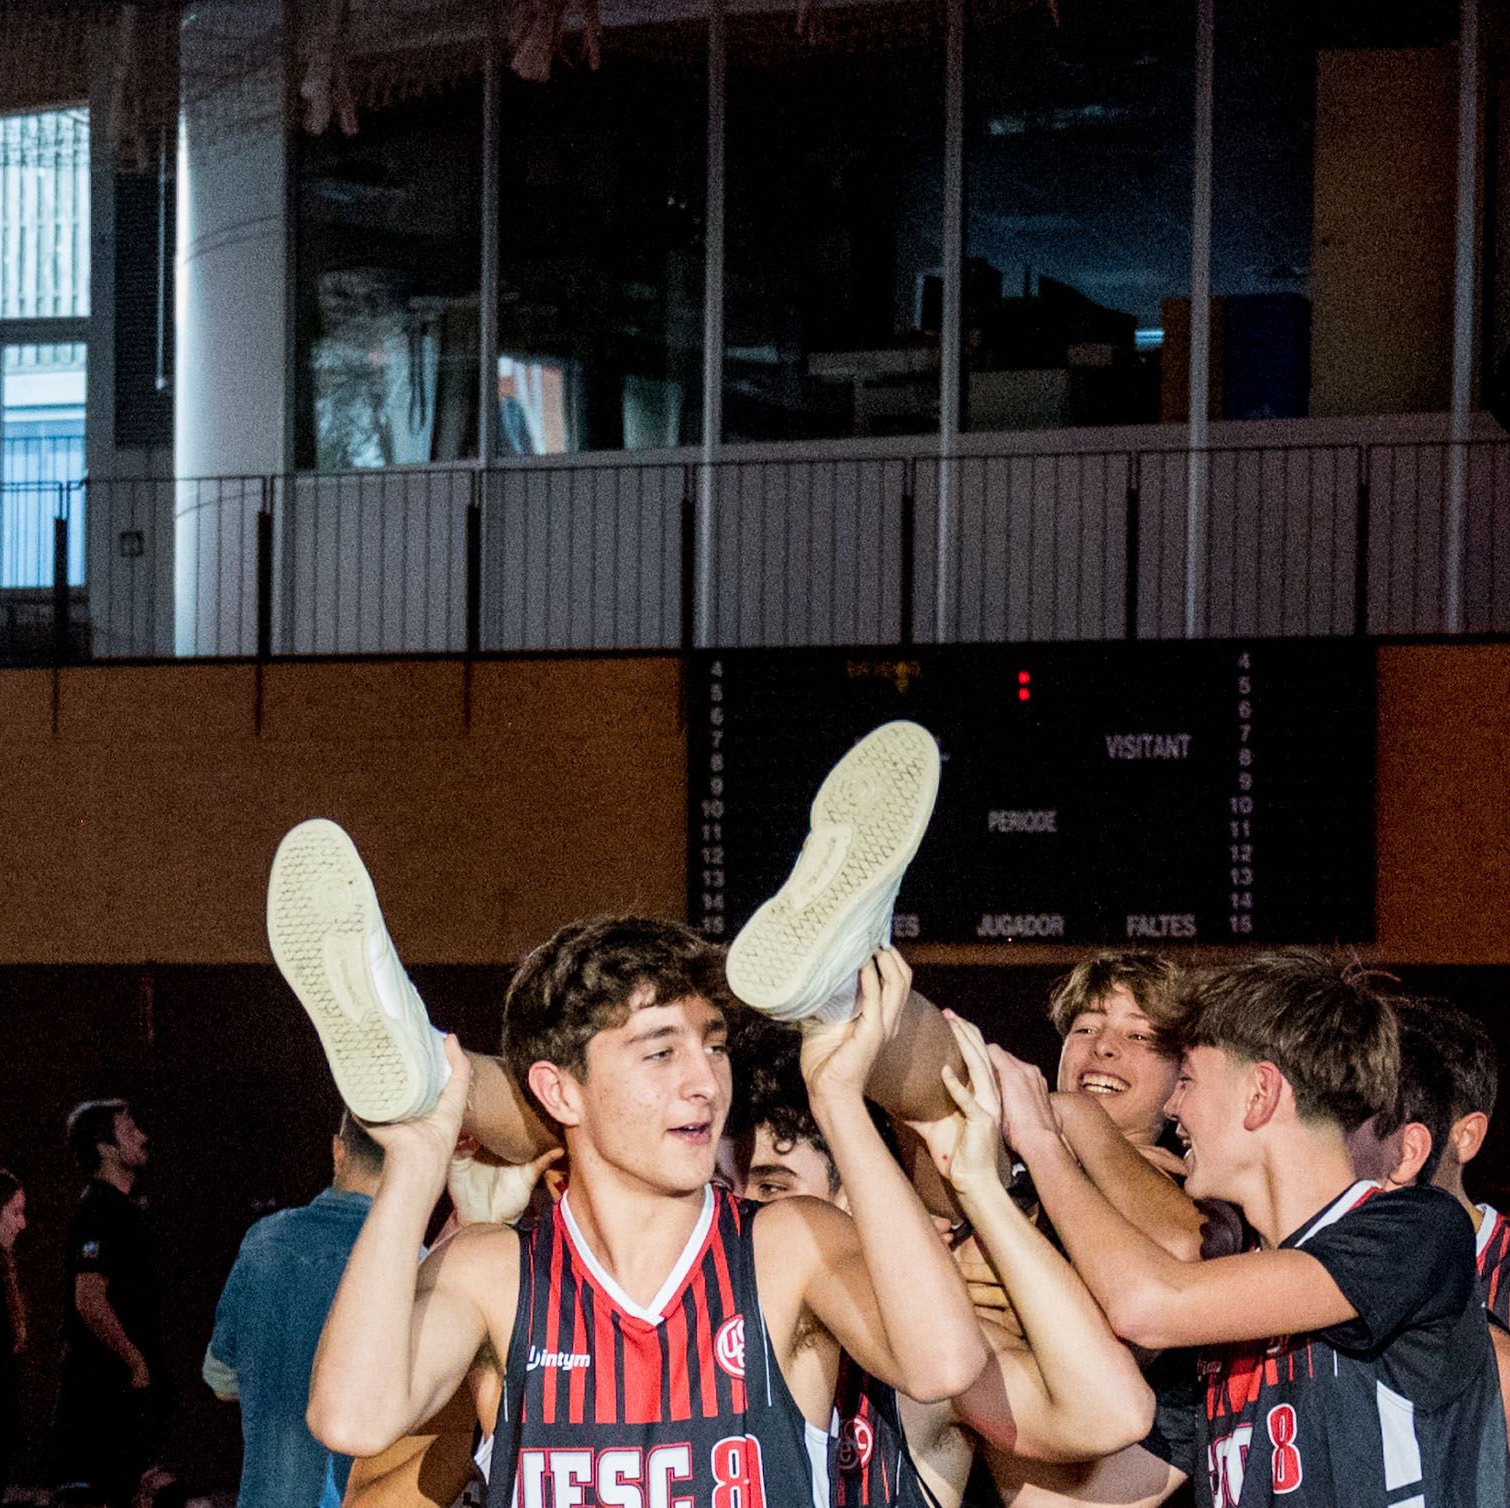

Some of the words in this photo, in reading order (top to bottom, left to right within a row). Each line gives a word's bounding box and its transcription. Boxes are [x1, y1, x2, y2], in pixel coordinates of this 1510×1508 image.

[710, 660, 723, 677] 4
[1238, 652, 1251, 669] 4
[710, 684, 723, 702] 5
[1238, 676, 1251, 694] 5
[710, 707, 724, 725] 6
[1238, 700, 1252, 718] 6
[710, 730, 723, 747] 7
[1240, 724, 1251, 741] 7
[1105, 732, 1191, 760] VISITANT
[710, 752, 724, 772] 8
[1239, 748, 1252, 766] 8
[710, 776, 724, 795] 9
[1239, 772, 1252, 790] 9
[702, 799, 724, 818] 10
[1230, 796, 1253, 814] 10
[702, 824, 722, 841] 11
[1230, 820, 1251, 838] 11
[702, 847, 724, 865] 12
[1230, 844, 1253, 862] 12
[702, 869, 725, 888] 13
[1230, 867, 1253, 886] 13
[702, 893, 724, 910] 14
[1230, 891, 1253, 909] 14
[702, 916, 724, 934] 15
[977, 914, 1064, 937] JUGADOR
[1126, 914, 1197, 937] FALTES
[1230, 914, 1253, 933] 15
[1267, 1403, 1302, 1494] 8
